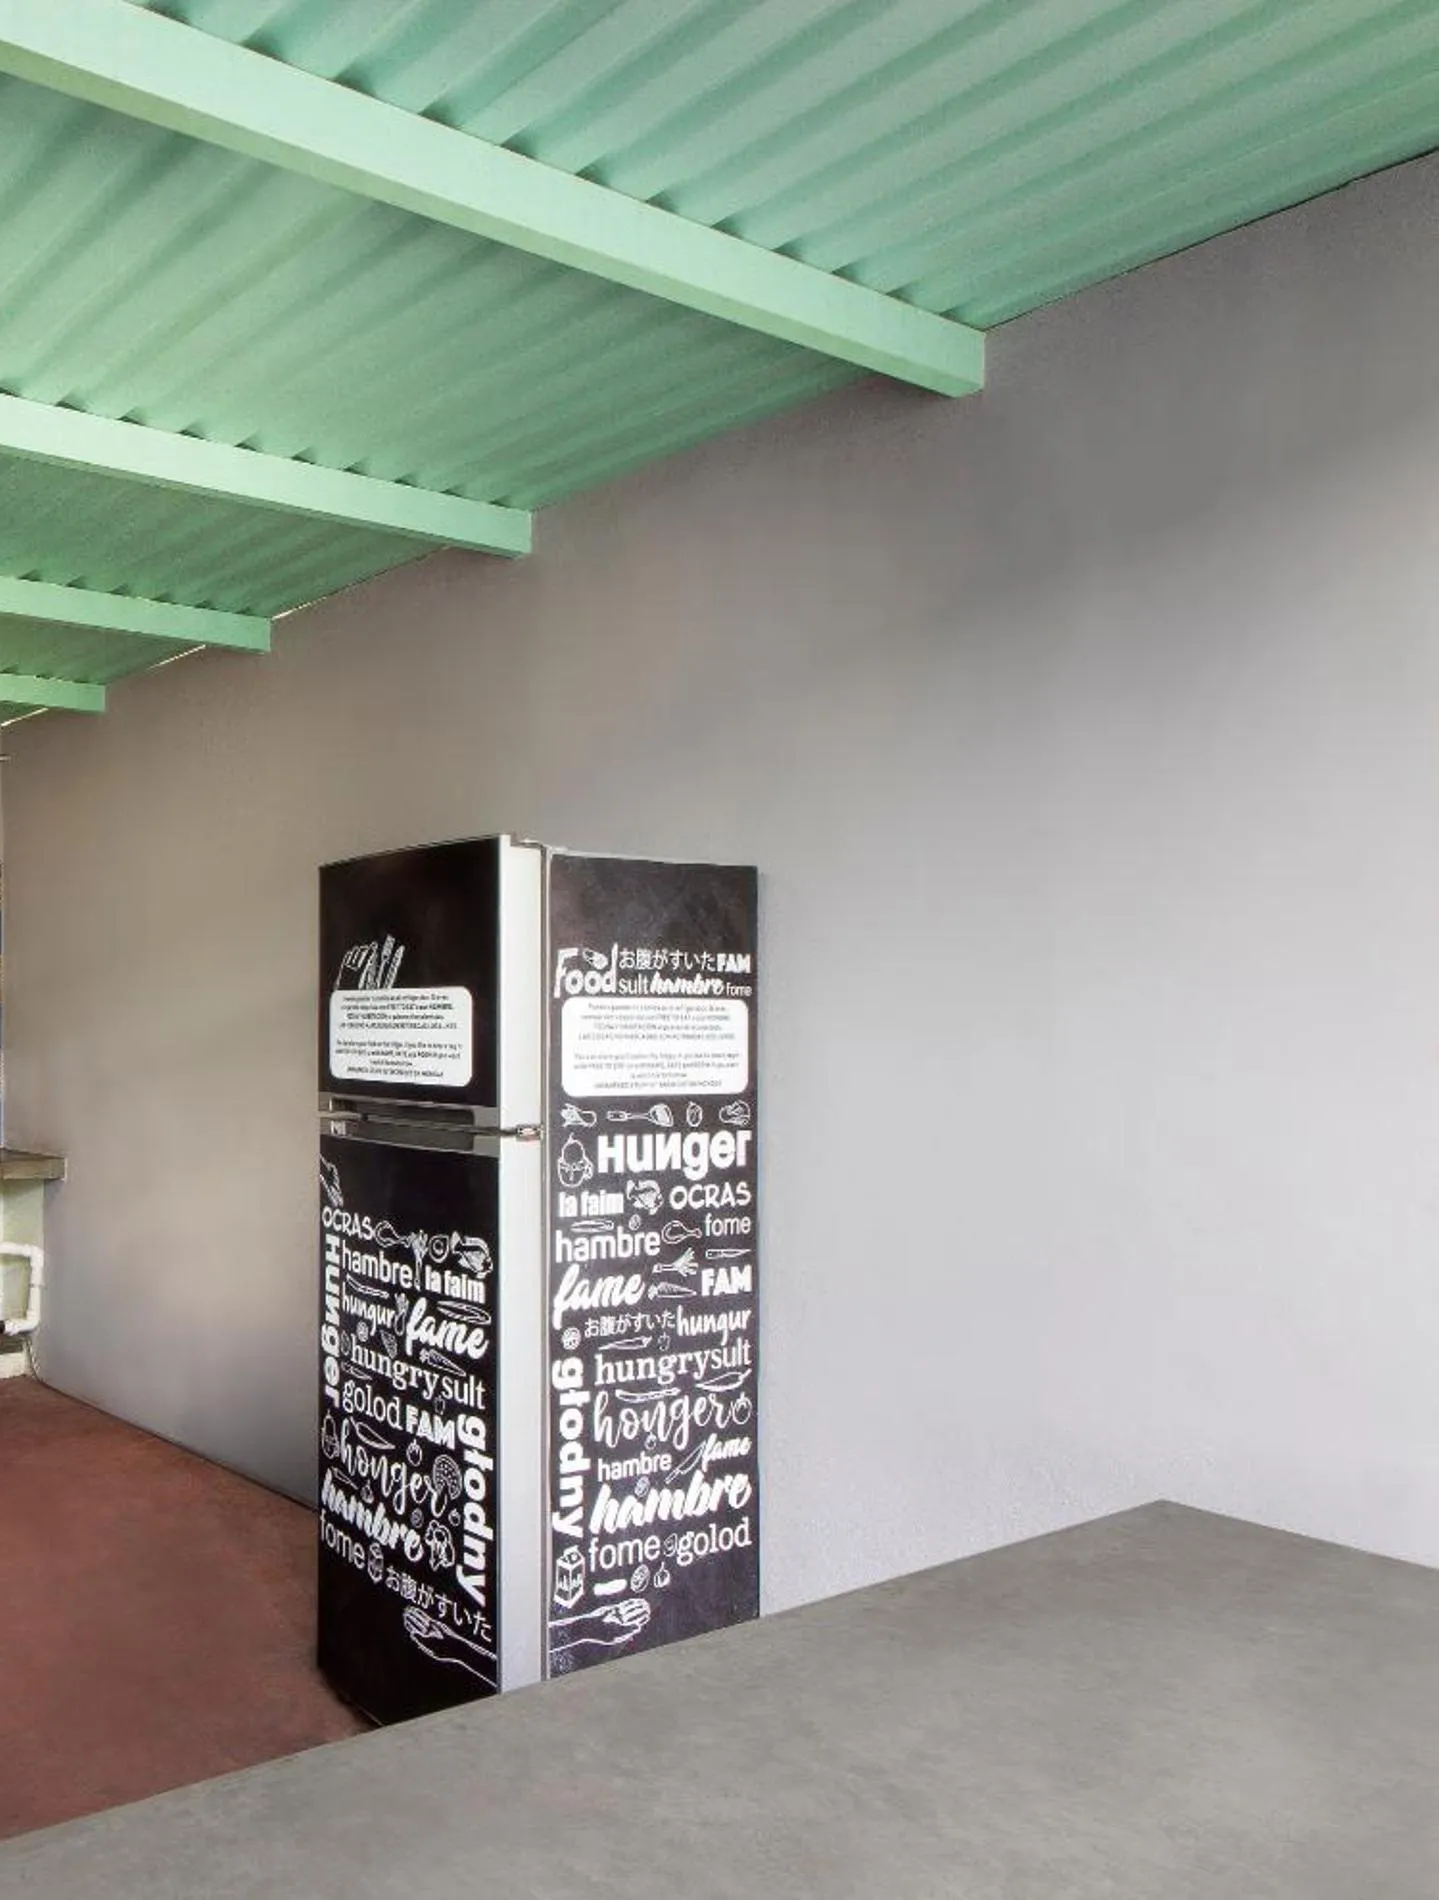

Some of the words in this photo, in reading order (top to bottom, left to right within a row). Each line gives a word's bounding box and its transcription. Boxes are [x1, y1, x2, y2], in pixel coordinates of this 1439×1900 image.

[554, 942, 618, 999] Food
[618, 973, 649, 995] sult
[717, 953, 751, 974] FAM
[559, 1191, 578, 1217] la
[581, 1189, 625, 1216] faim
[669, 1181, 752, 1210] OCRAS
[321, 1206, 373, 1241] OCRAS
[555, 1226, 661, 1263] hambre
[705, 1213, 752, 1237] fome
[342, 1240, 413, 1289] hambre
[424, 1265, 442, 1292] la
[444, 1270, 486, 1304] faim
[701, 1264, 752, 1297] FAM
[552, 1264, 646, 1330] fame
[405, 1297, 490, 1360] fame
[677, 1304, 752, 1346] hungur
[350, 1333, 440, 1400] hungry
[440, 1375, 486, 1410] sult
[594, 1349, 712, 1386] hungry
[711, 1336, 753, 1370] sult
[342, 1380, 403, 1431] golod
[593, 1391, 733, 1450] honger
[405, 1405, 456, 1450] FAM
[598, 1451, 673, 1482] hambre
[589, 1469, 752, 1534] hambre
[320, 1507, 366, 1570] fome
[588, 1535, 661, 1572] fome
[677, 1517, 752, 1566] golod
